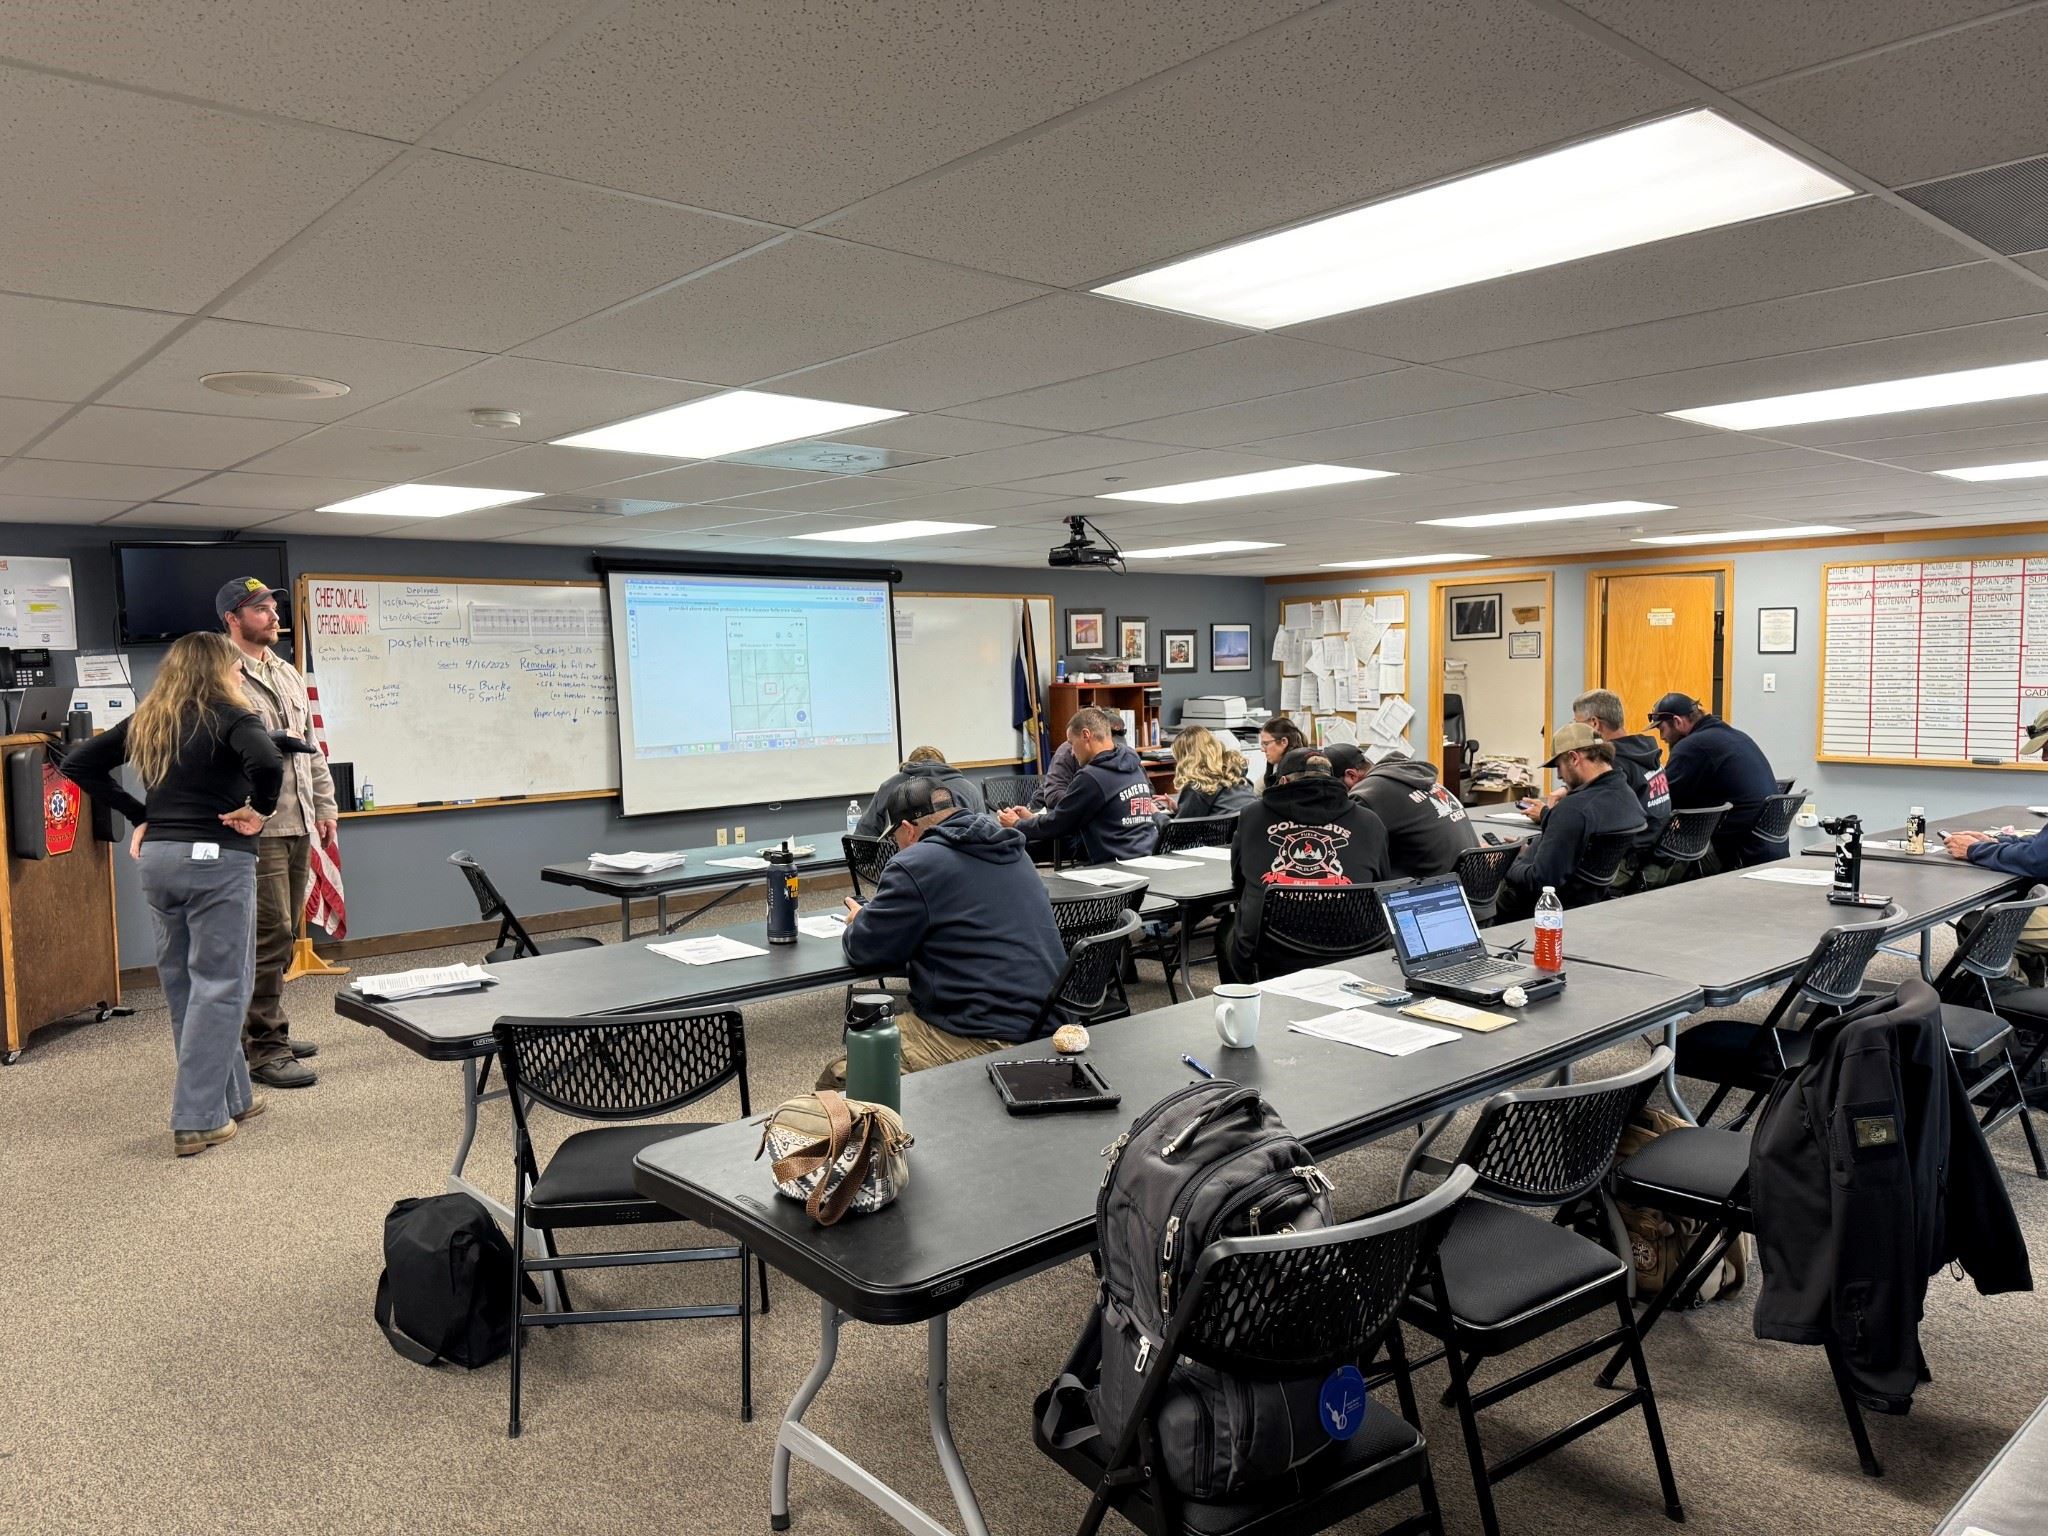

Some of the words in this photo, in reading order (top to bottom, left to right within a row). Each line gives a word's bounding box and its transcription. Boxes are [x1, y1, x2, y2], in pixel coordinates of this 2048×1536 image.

[1972, 560, 2005, 569] STATION
[1875, 581, 1899, 590] CAPTAIN
[1923, 579, 1948, 587] CAPTAIN
[1972, 577, 1999, 586] CAPTAIN
[1865, 590, 1872, 599] A
[1911, 589, 1920, 597] B
[1961, 587, 1970, 595] C
[315, 587, 334, 608] CHIEF
[335, 588, 347, 608] ON
[1922, 596, 1960, 604] LIEUTENANT
[1972, 594, 2012, 602] LIEUTENANT
[317, 614, 341, 635] OFFICER
[479, 680, 512, 692] Burke
[1648, 773, 1670, 799] FIR
[1130, 797, 1152, 816] FIR
